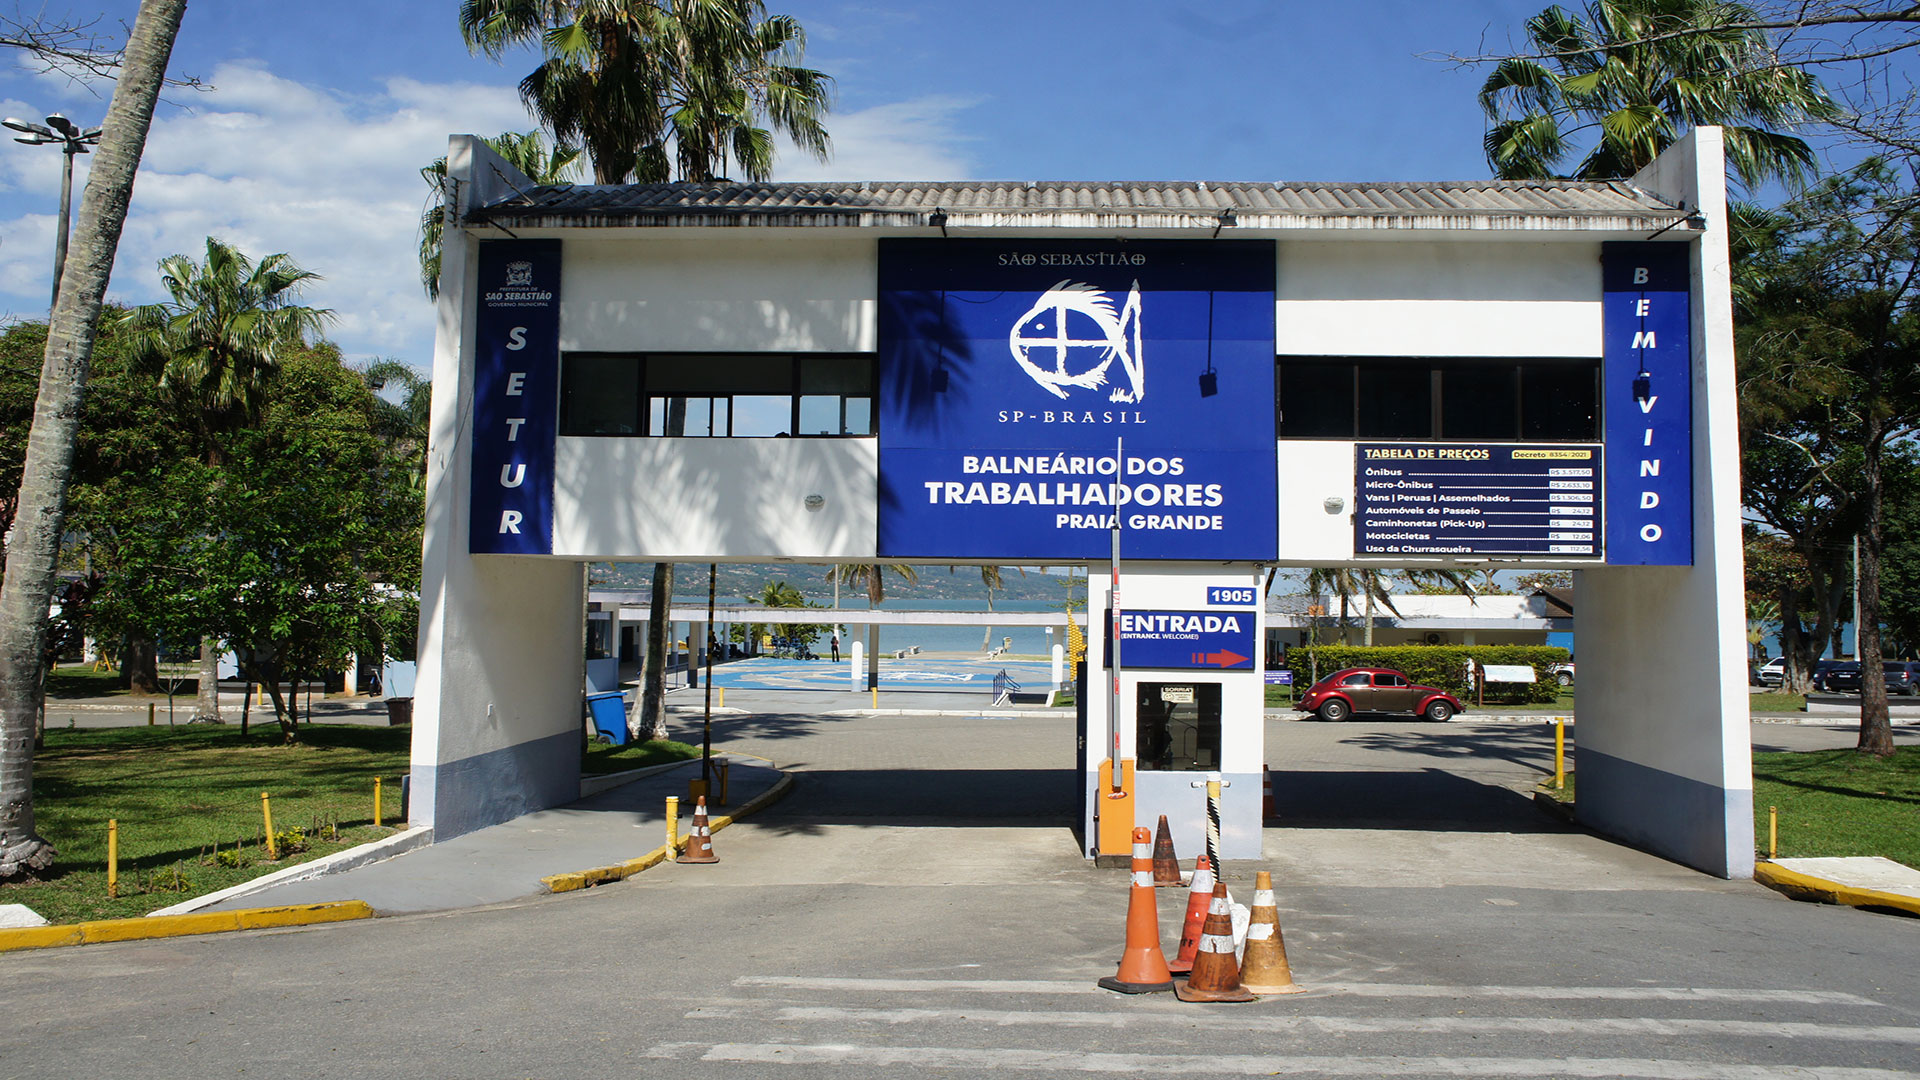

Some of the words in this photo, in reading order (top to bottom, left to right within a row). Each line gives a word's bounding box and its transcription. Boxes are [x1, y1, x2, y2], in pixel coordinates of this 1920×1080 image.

[998, 252, 1036, 266] SÃO
[1040, 252, 1146, 266] SEBASTIÃO
[504, 290, 552, 301] SEBASTIÃO
[1365, 449, 1414, 458] TABELA
[1417, 449, 1435, 458] DE
[1439, 449, 1490, 461] PREÇOS
[963, 452, 1118, 475] BALNEÁRIO
[1127, 457, 1184, 475] DOS
[1365, 467, 1403, 476] Ônibus
[1365, 480, 1434, 489] Micro-Ônibus
[924, 481, 1223, 506] TRABALHADORES
[1438, 494, 1511, 502] Assemelhados
[1365, 506, 1424, 515] Automóveis
[1427, 507, 1440, 515] de
[1443, 507, 1481, 515] Passeio
[1128, 514, 1223, 530] GRANDE
[1365, 519, 1438, 527] Caminhonetas
[1440, 520, 1486, 529] (Pick-Up)
[1365, 532, 1430, 540] Motocicletas
[1401, 545, 1472, 553] Churrasqueira
[1211, 590, 1253, 603] 1905
[1120, 615, 1241, 633] ENTRADA
